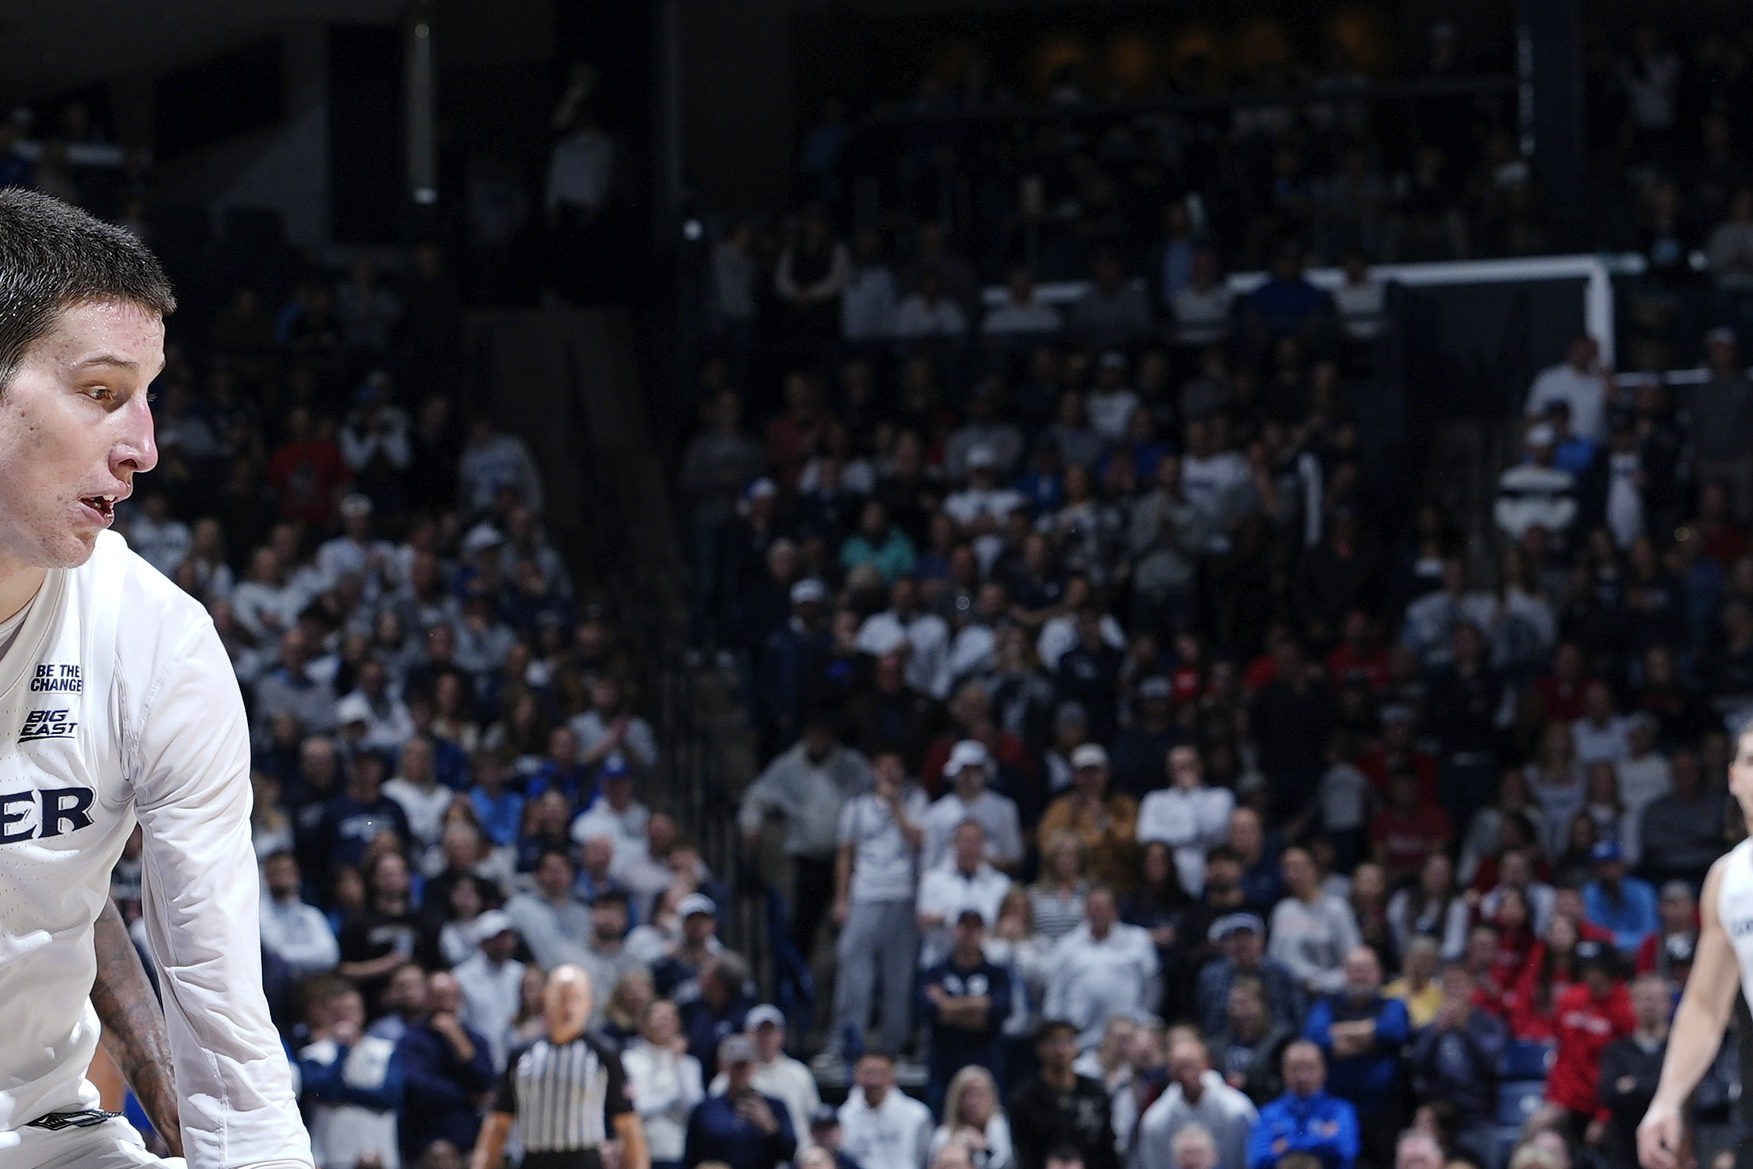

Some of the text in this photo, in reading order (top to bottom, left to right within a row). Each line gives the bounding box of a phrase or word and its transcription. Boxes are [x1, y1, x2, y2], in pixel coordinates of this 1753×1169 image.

[36, 664, 80, 678] BE THE
[30, 678, 83, 692] CHANGE
[26, 709, 70, 723] BIG
[20, 723, 78, 736] EAST
